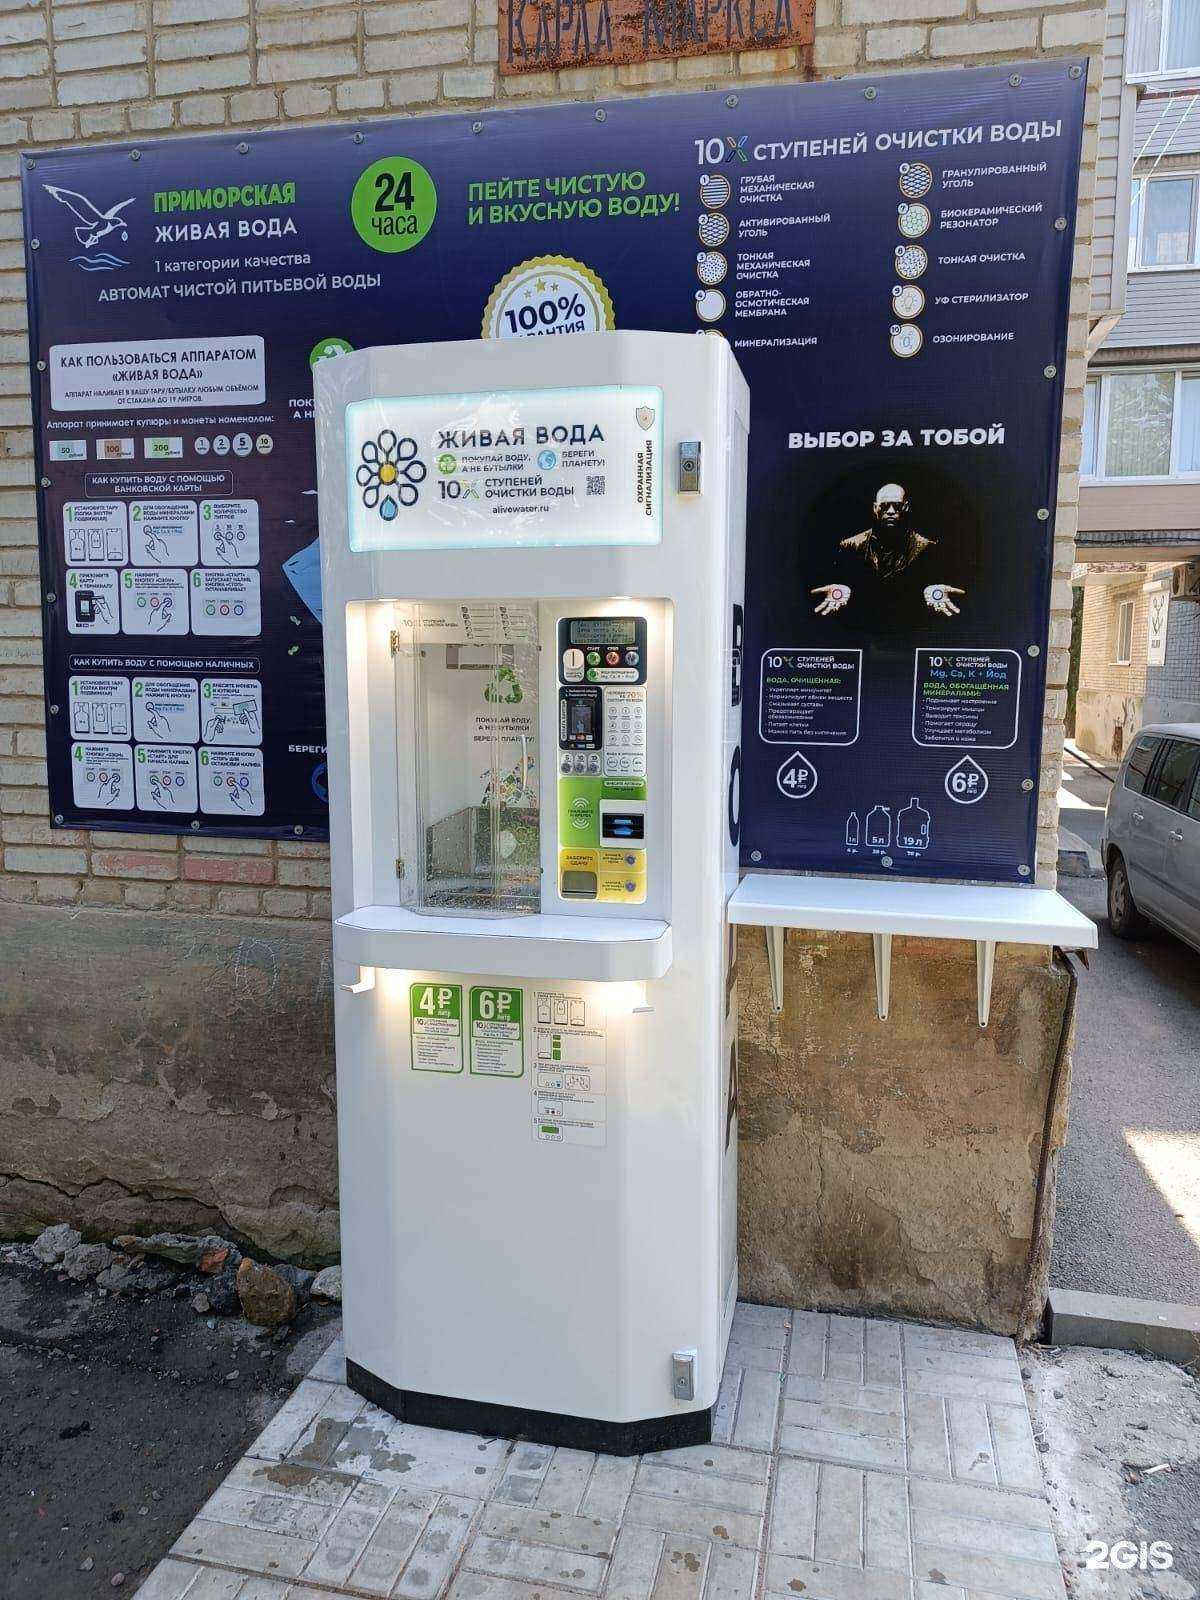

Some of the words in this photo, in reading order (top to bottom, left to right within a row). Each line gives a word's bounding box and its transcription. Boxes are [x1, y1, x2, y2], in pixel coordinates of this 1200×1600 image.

[754, 134, 867, 161] СТУПЕНЕЙ
[875, 126, 982, 151] ОЧИСТКИ
[990, 120, 1062, 144] ВОДЫ
[942, 162, 1047, 179] ГРАНУЛИРОВАННЫЙ
[469, 177, 540, 201] ПЕЙТЕ
[545, 171, 645, 197] ЧИСТУЮ
[740, 175, 775, 184] ГРУБАЯ
[942, 178, 974, 189] УГОЛЬ
[374, 172, 414, 212] 24
[740, 182, 815, 194] МЕХАНИЧЕСКАЯ
[154, 183, 296, 213] ПРИМОРСКАЯ
[739, 193, 782, 203] ОЧИСТКА
[468, 207, 483, 225] И
[490, 198, 601, 225] ВКУСНУЮ
[608, 193, 680, 218] ВОДУ!
[941, 203, 1042, 218] БИОКЕРАМИЧЕСКИЙ
[372, 217, 418, 236] часа
[739, 213, 831, 227] АКТИВИРОВАННЫЙ
[940, 218, 999, 229] РЕЗОНАТОР
[155, 220, 230, 243] ЖИВАЯ
[239, 218, 298, 238] ВОДА
[738, 228, 768, 238] УГОЛЬ
[155, 261, 161, 272] 1
[164, 257, 240, 274] категории
[244, 253, 311, 267] качества
[737, 252, 774, 261] ТОНКАЯ
[938, 254, 977, 265] ТОНКАЯ
[979, 252, 1026, 263] ОЧИСТКА
[737, 259, 810, 271] МЕХАНИЧЕСКАЯ
[736, 270, 779, 280] ОЧИСТКА
[99, 286, 170, 302] АВТОМАТ
[174, 278, 236, 297] ЧИСТОЙ
[242, 274, 327, 294] ПИТЬЕВОЙ
[332, 274, 381, 290] ВОДЫ
[735, 289, 782, 299] ОБРАТНО-
[735, 297, 810, 308] ОСМОТИЧЕСКАЯ
[935, 295, 949, 306] УФ
[951, 292, 1029, 304] СТЕРИЛИЗАТОР
[505, 293, 585, 333] 100%
[735, 308, 787, 318] МЕМБРАНА
[735, 337, 818, 349] МИНЕРАЛИЗАЦИЯ
[932, 332, 1014, 343] ОЗОНИРОВАНИЕ
[61, 357, 83, 367] КАК
[86, 353, 177, 366] ПОЛЬЗОВАТЬСЯ
[181, 349, 256, 362] АППАРАТОМ
[112, 369, 159, 382] «ЖИВАЯ
[162, 368, 202, 380] ВОДА»
[86, 420, 134, 428] принимает
[136, 418, 171, 427] купюры
[240, 438, 245, 446] 5
[438, 428, 525, 448] ЖИВАЯ
[536, 424, 604, 445] ВОДА
[788, 431, 875, 448] ВЫБОР
[881, 430, 913, 447] ЗА
[920, 423, 1005, 445] ТОБОЙ
[462, 454, 503, 462] ПОКУПАЙ
[506, 454, 531, 462] ВОДУ,
[562, 459, 605, 467] ПЛАНЕТУ!
[144, 475, 168, 484] ВОДУ
[177, 475, 225, 483] ПОМОЩЬЮ
[485, 474, 542, 486] СТУПЕНЕЙ
[114, 484, 171, 493] БАНКОВСКОЙ
[485, 488, 537, 498] ОЧИСТКИ
[540, 487, 574, 497] ВОДЫ
[66, 507, 72, 522] 1
[133, 506, 141, 521] 2
[204, 505, 211, 520] 3
[492, 505, 549, 514] alivewater.ru
[69, 573, 77, 588] 4
[124, 573, 132, 588] 5
[193, 572, 201, 587] 6
[92, 659, 123, 667] КУПИТЬ
[125, 660, 147, 668] ВОДУ
[156, 660, 203, 669] ПОМОЩЬЮ
[206, 660, 254, 669] НАЛИЧНЫХ
[986, 669, 1006, 679] Йод
[72, 681, 78, 696] 1
[135, 682, 143, 697] 2
[204, 683, 211, 698] 3
[74, 746, 83, 761] 4
[138, 749, 146, 763] 5
[201, 751, 209, 765] 6
